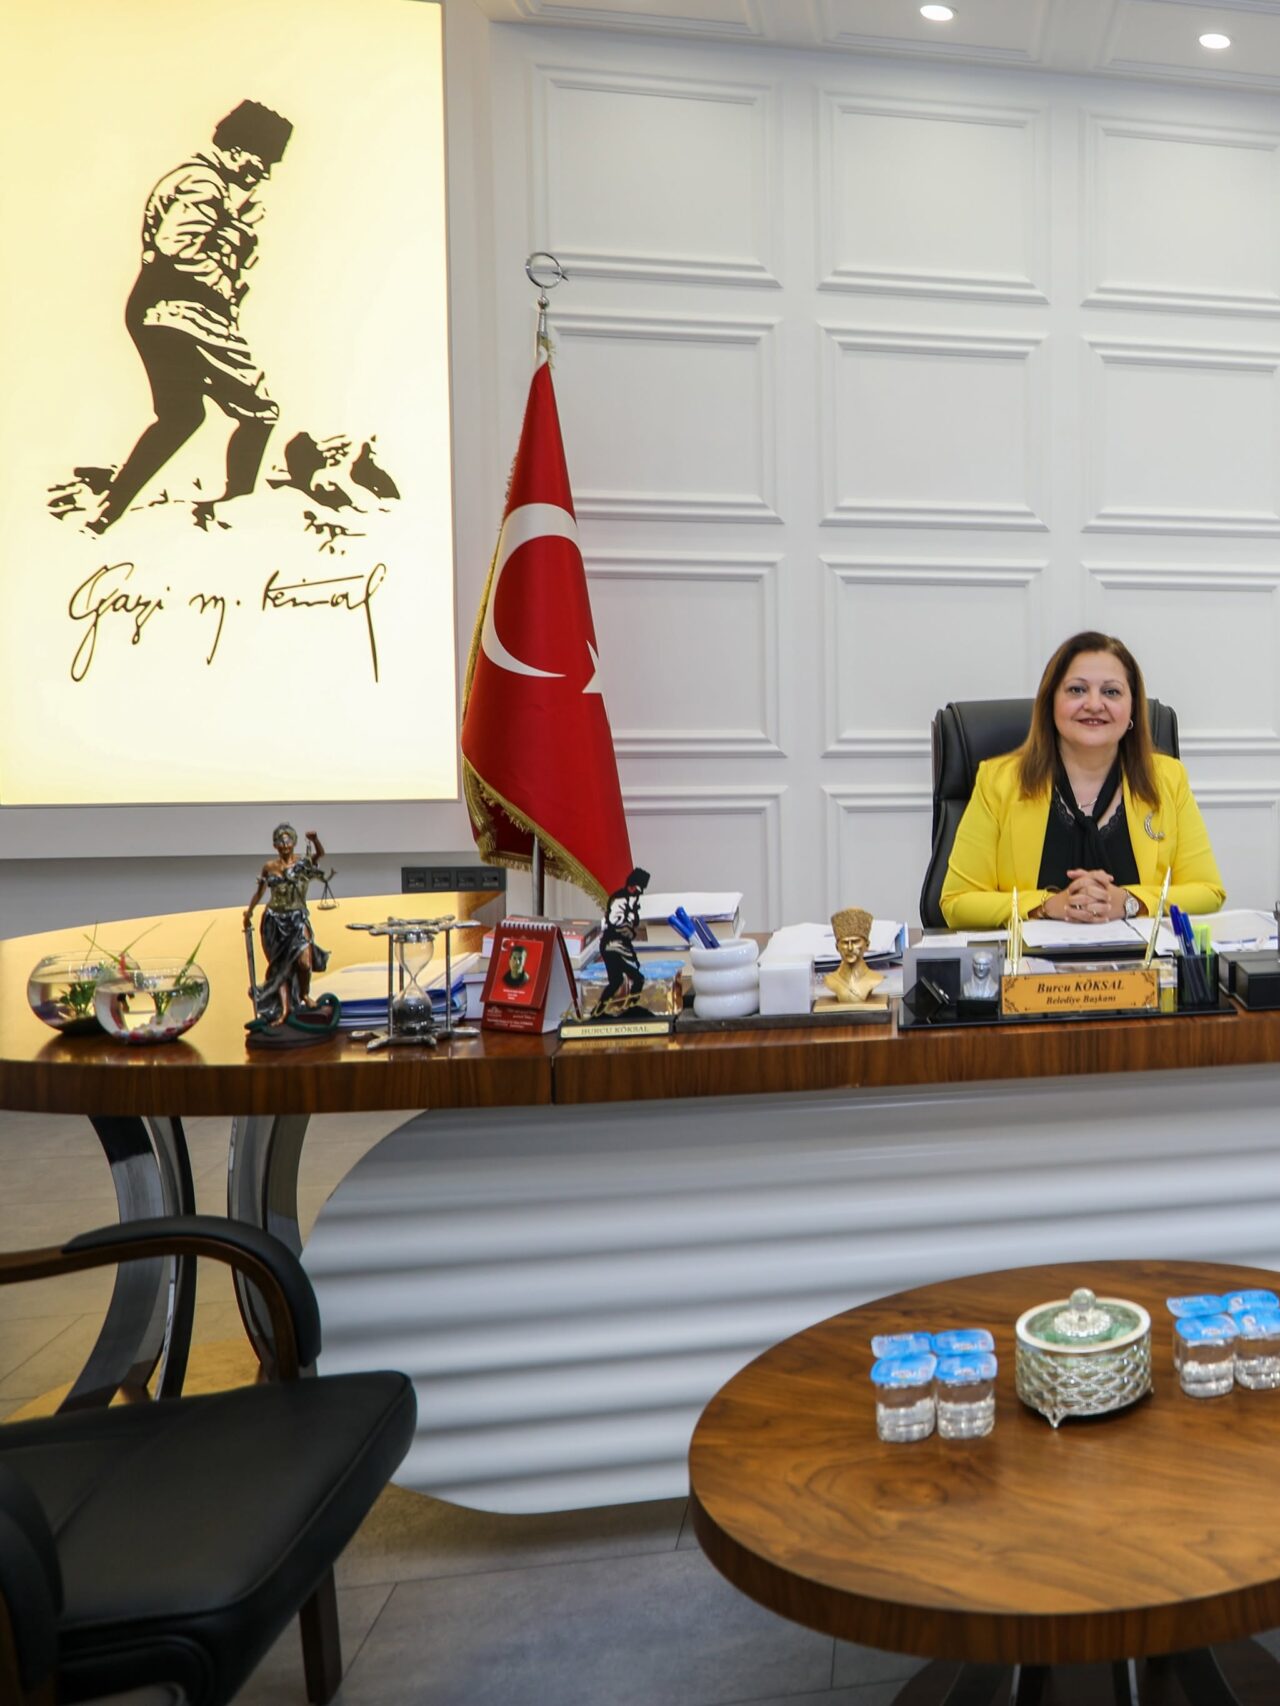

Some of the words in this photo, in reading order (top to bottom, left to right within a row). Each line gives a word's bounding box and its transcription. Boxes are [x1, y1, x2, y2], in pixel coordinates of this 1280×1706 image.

[1036, 983, 1071, 994] Burcu
[1074, 978, 1124, 992] KÖKSAL
[1046, 996, 1081, 1006] Belediye
[1083, 993, 1116, 1004] Başkanı
